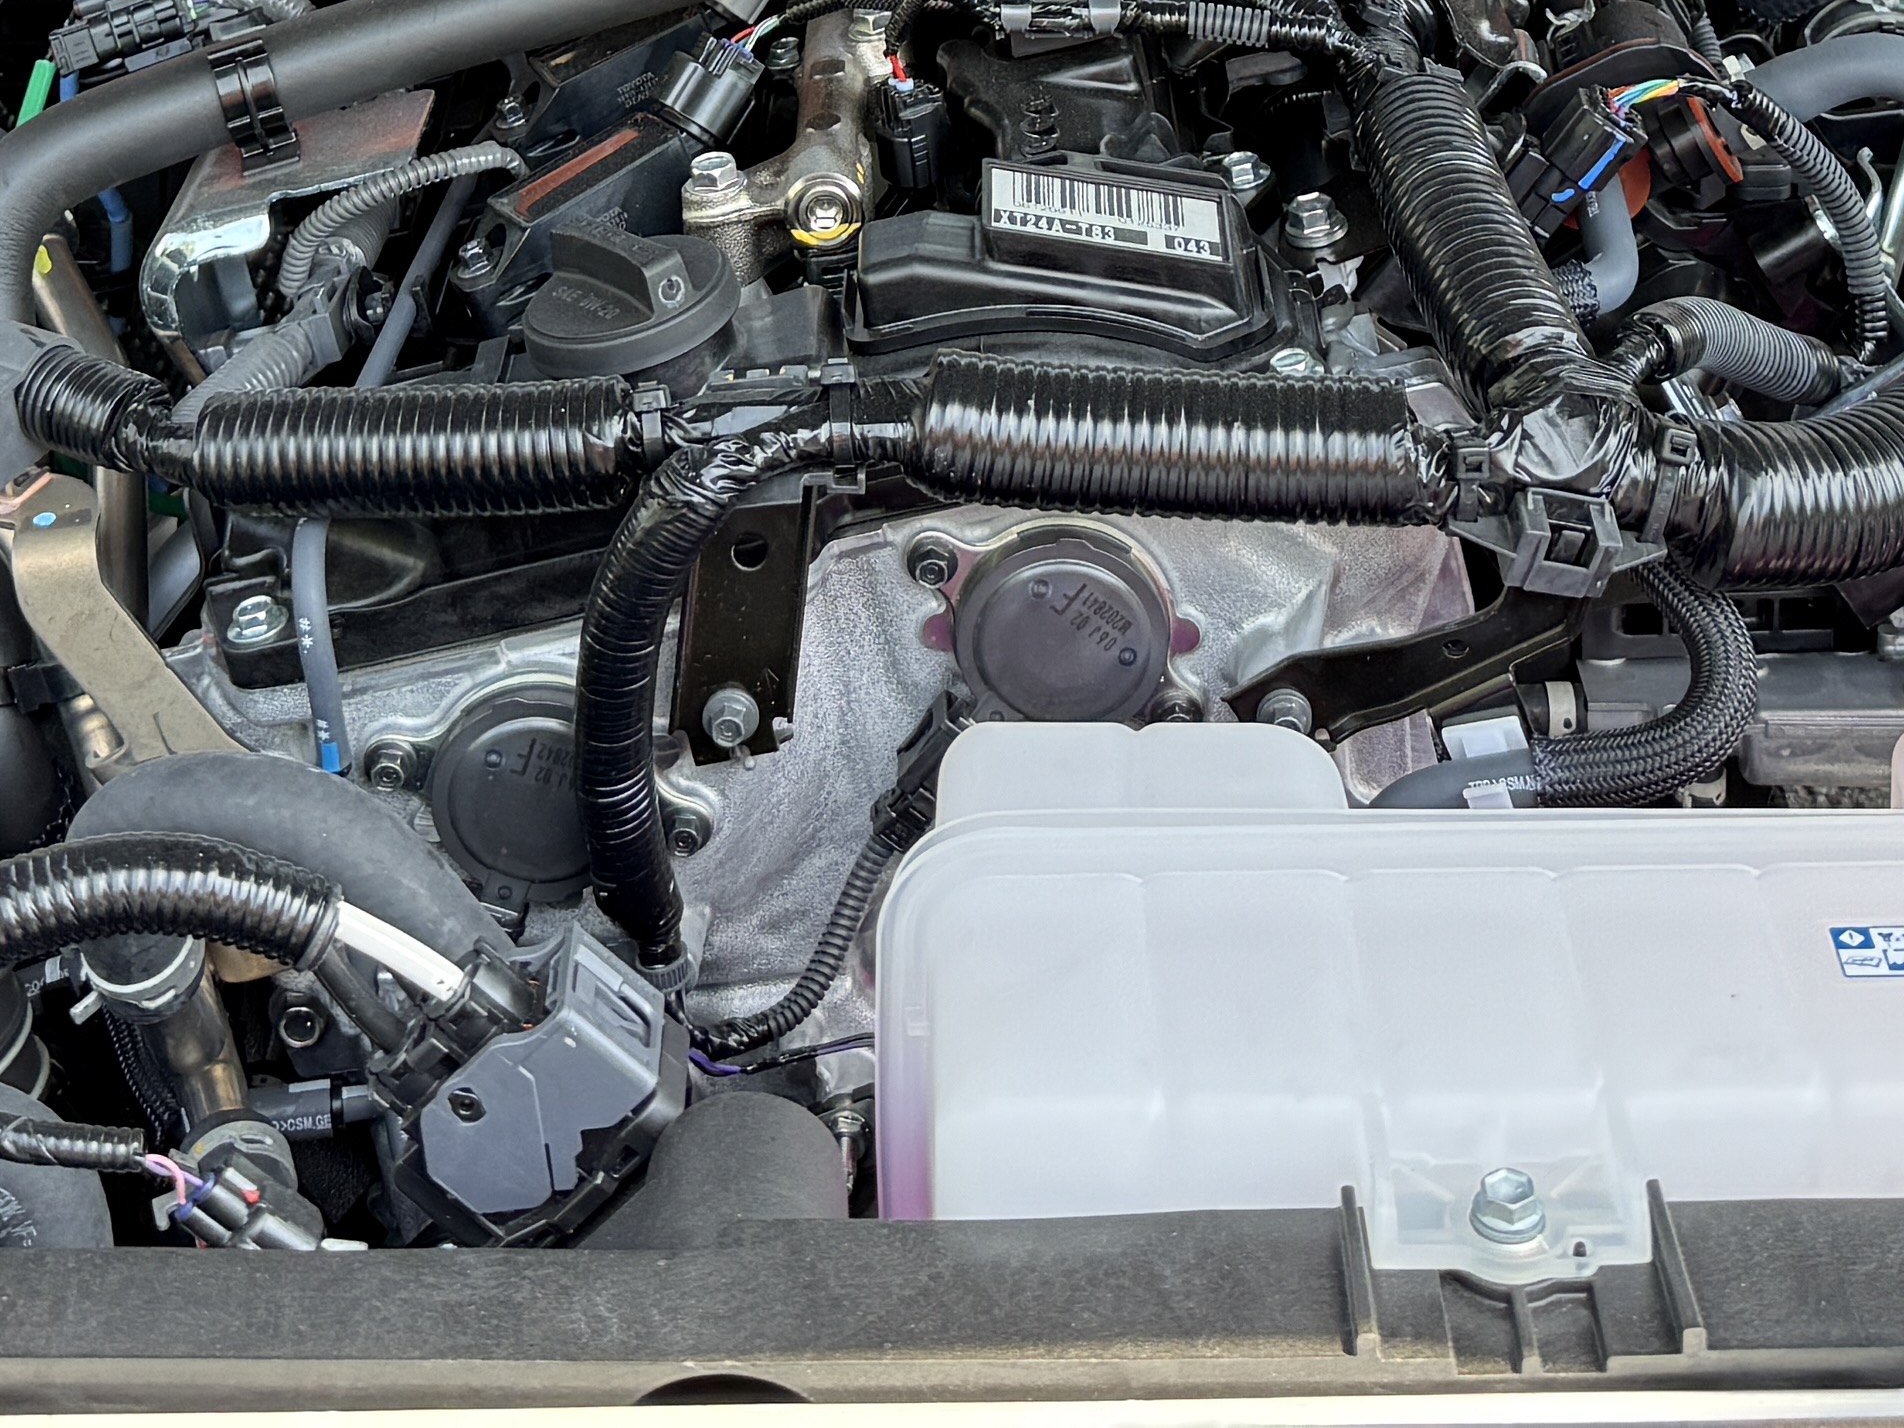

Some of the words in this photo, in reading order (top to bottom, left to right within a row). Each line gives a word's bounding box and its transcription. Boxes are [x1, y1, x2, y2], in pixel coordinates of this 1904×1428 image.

[616, 70, 655, 94] TOYOTA
[998, 209, 1116, 241] XT24A-T83
[1173, 236, 1211, 255] 043
[552, 285, 582, 302] SAE
